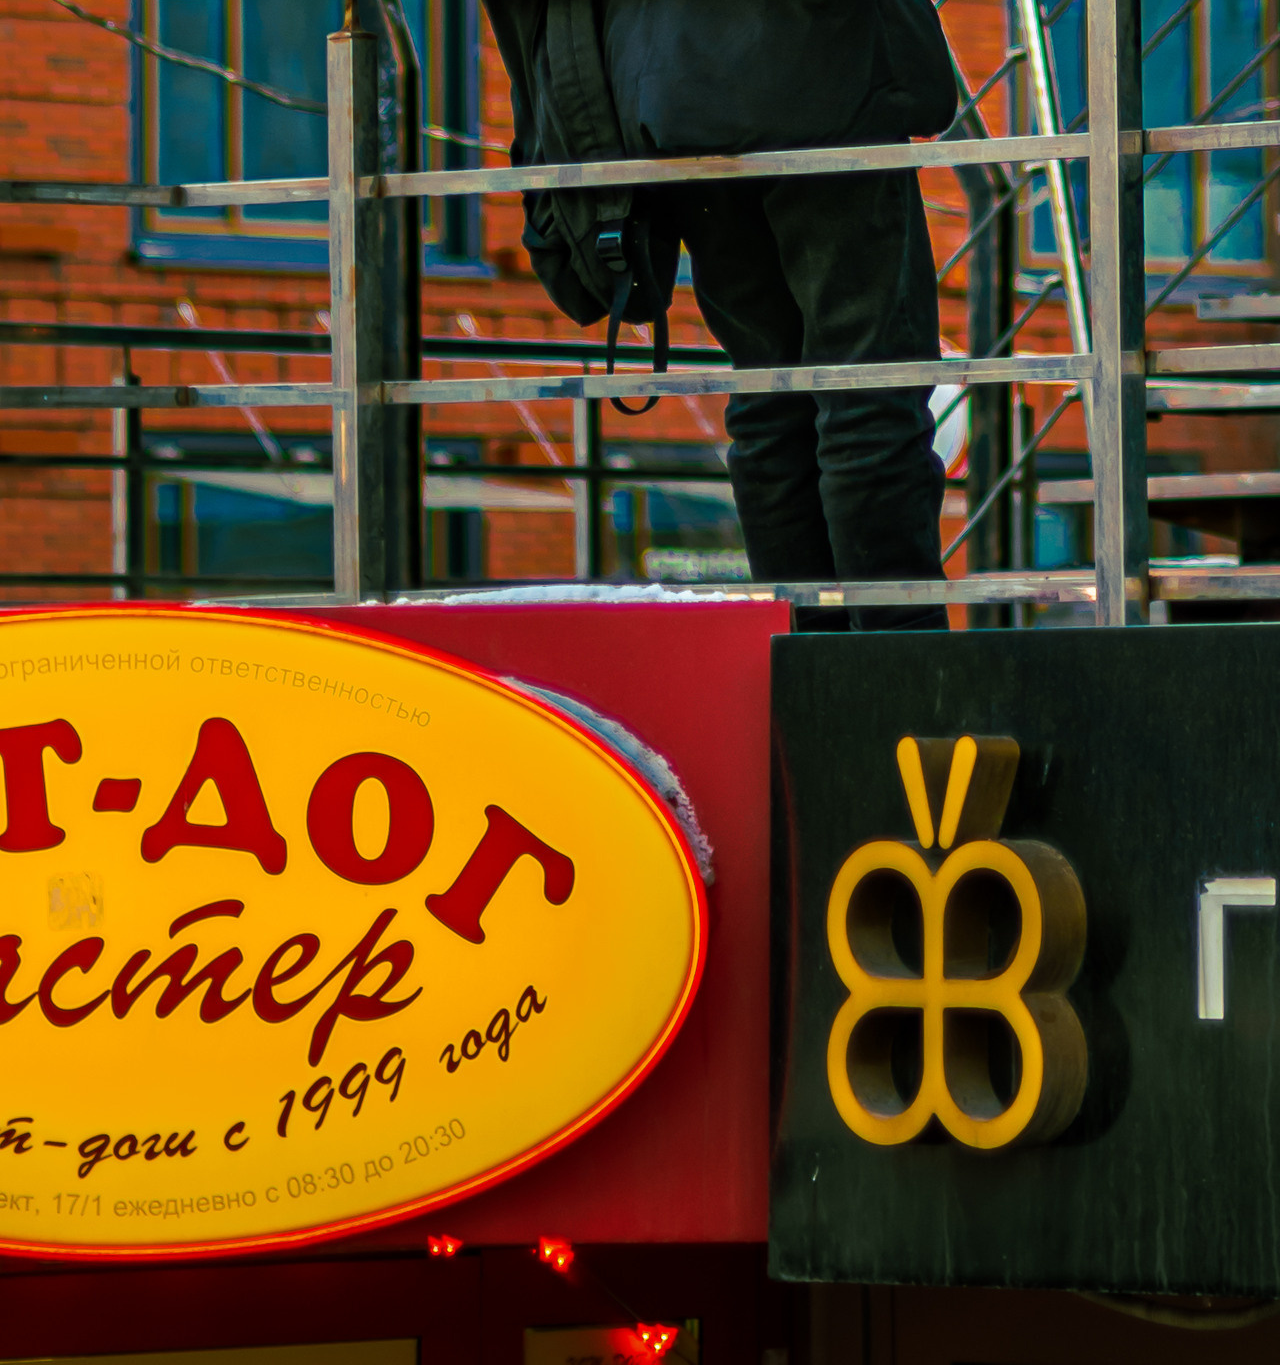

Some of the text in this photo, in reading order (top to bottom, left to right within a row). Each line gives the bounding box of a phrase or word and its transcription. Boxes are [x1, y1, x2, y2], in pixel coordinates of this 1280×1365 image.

[189, 651, 432, 729] ответственностью
[223, 1121, 250, 1152] с
[276, 1046, 406, 1138] 1999
[438, 985, 548, 1074] года
[53, 1192, 102, 1217] 17/1
[113, 1188, 257, 1219] ежедневно
[265, 1186, 280, 1204] с
[286, 1162, 355, 1200] 08:30
[364, 1155, 394, 1182] до
[399, 1118, 467, 1166] 20:30
